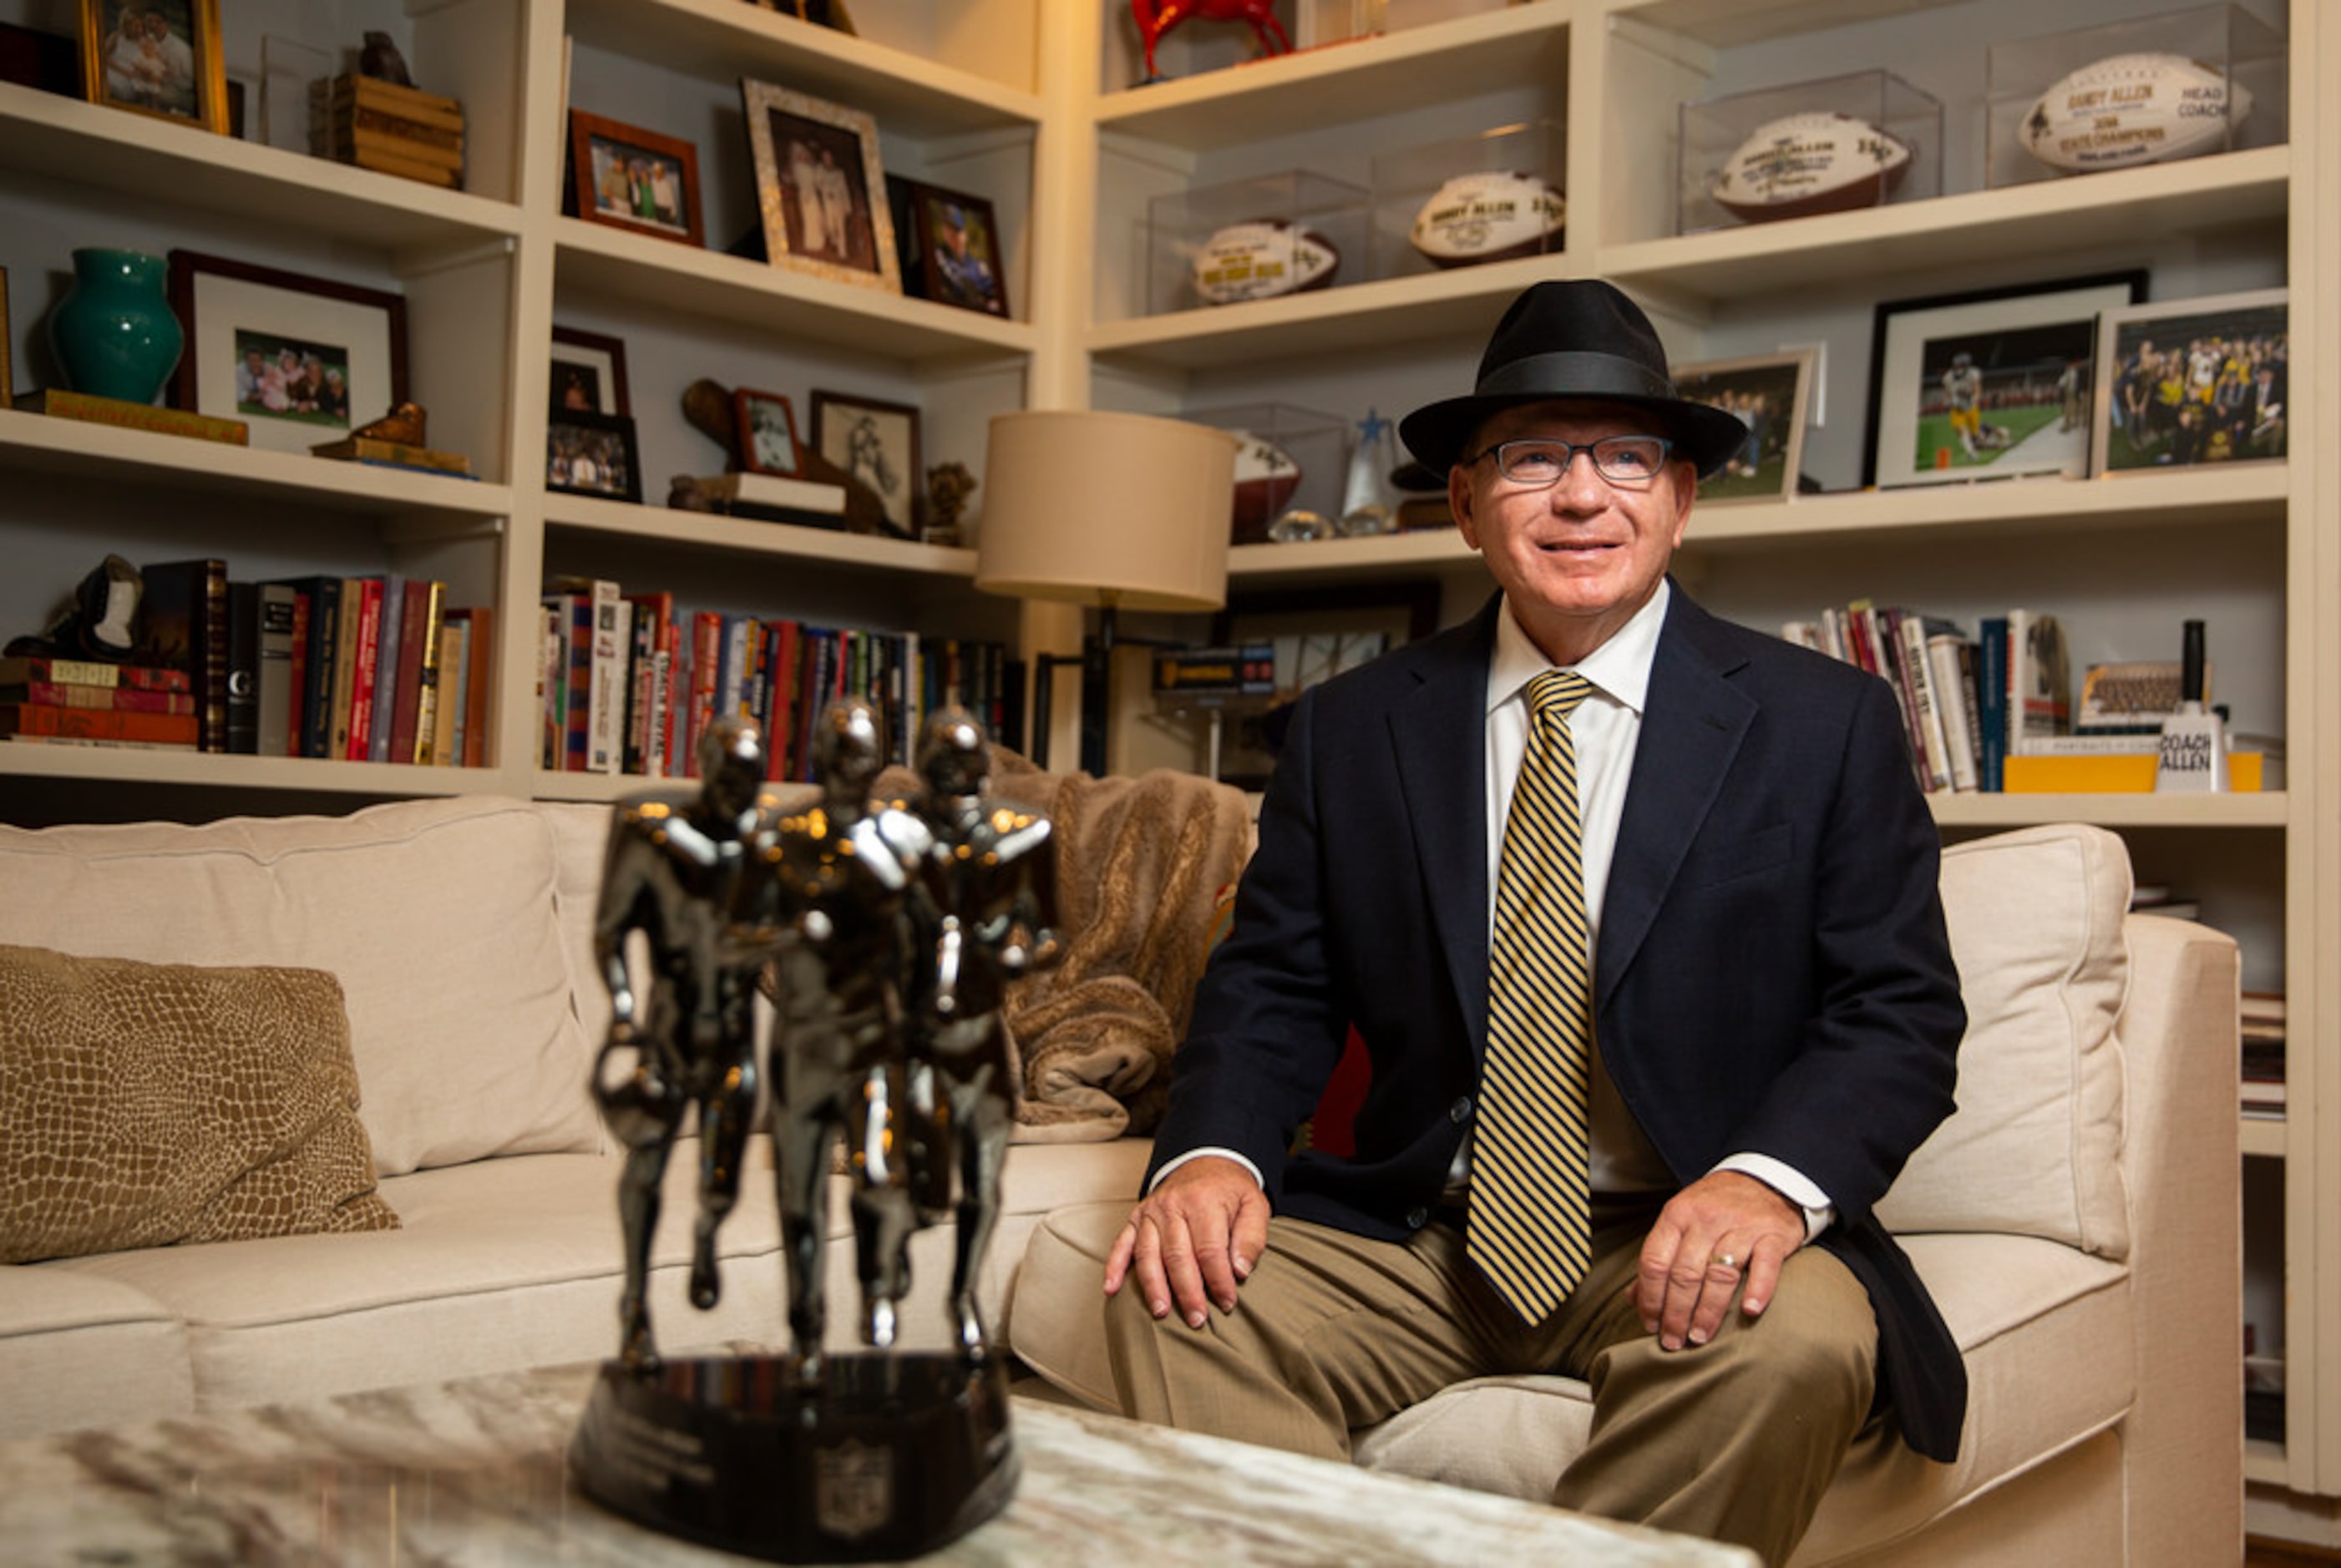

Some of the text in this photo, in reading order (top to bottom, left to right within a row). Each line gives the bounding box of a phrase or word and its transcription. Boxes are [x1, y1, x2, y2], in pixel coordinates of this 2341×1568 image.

[2111, 83, 2154, 102] ALLEN
[2181, 87, 2222, 100] HEAD
[2177, 102, 2229, 118] COACH
[2160, 733, 2211, 751] COACH
[2160, 751, 2211, 771] ALLEN
